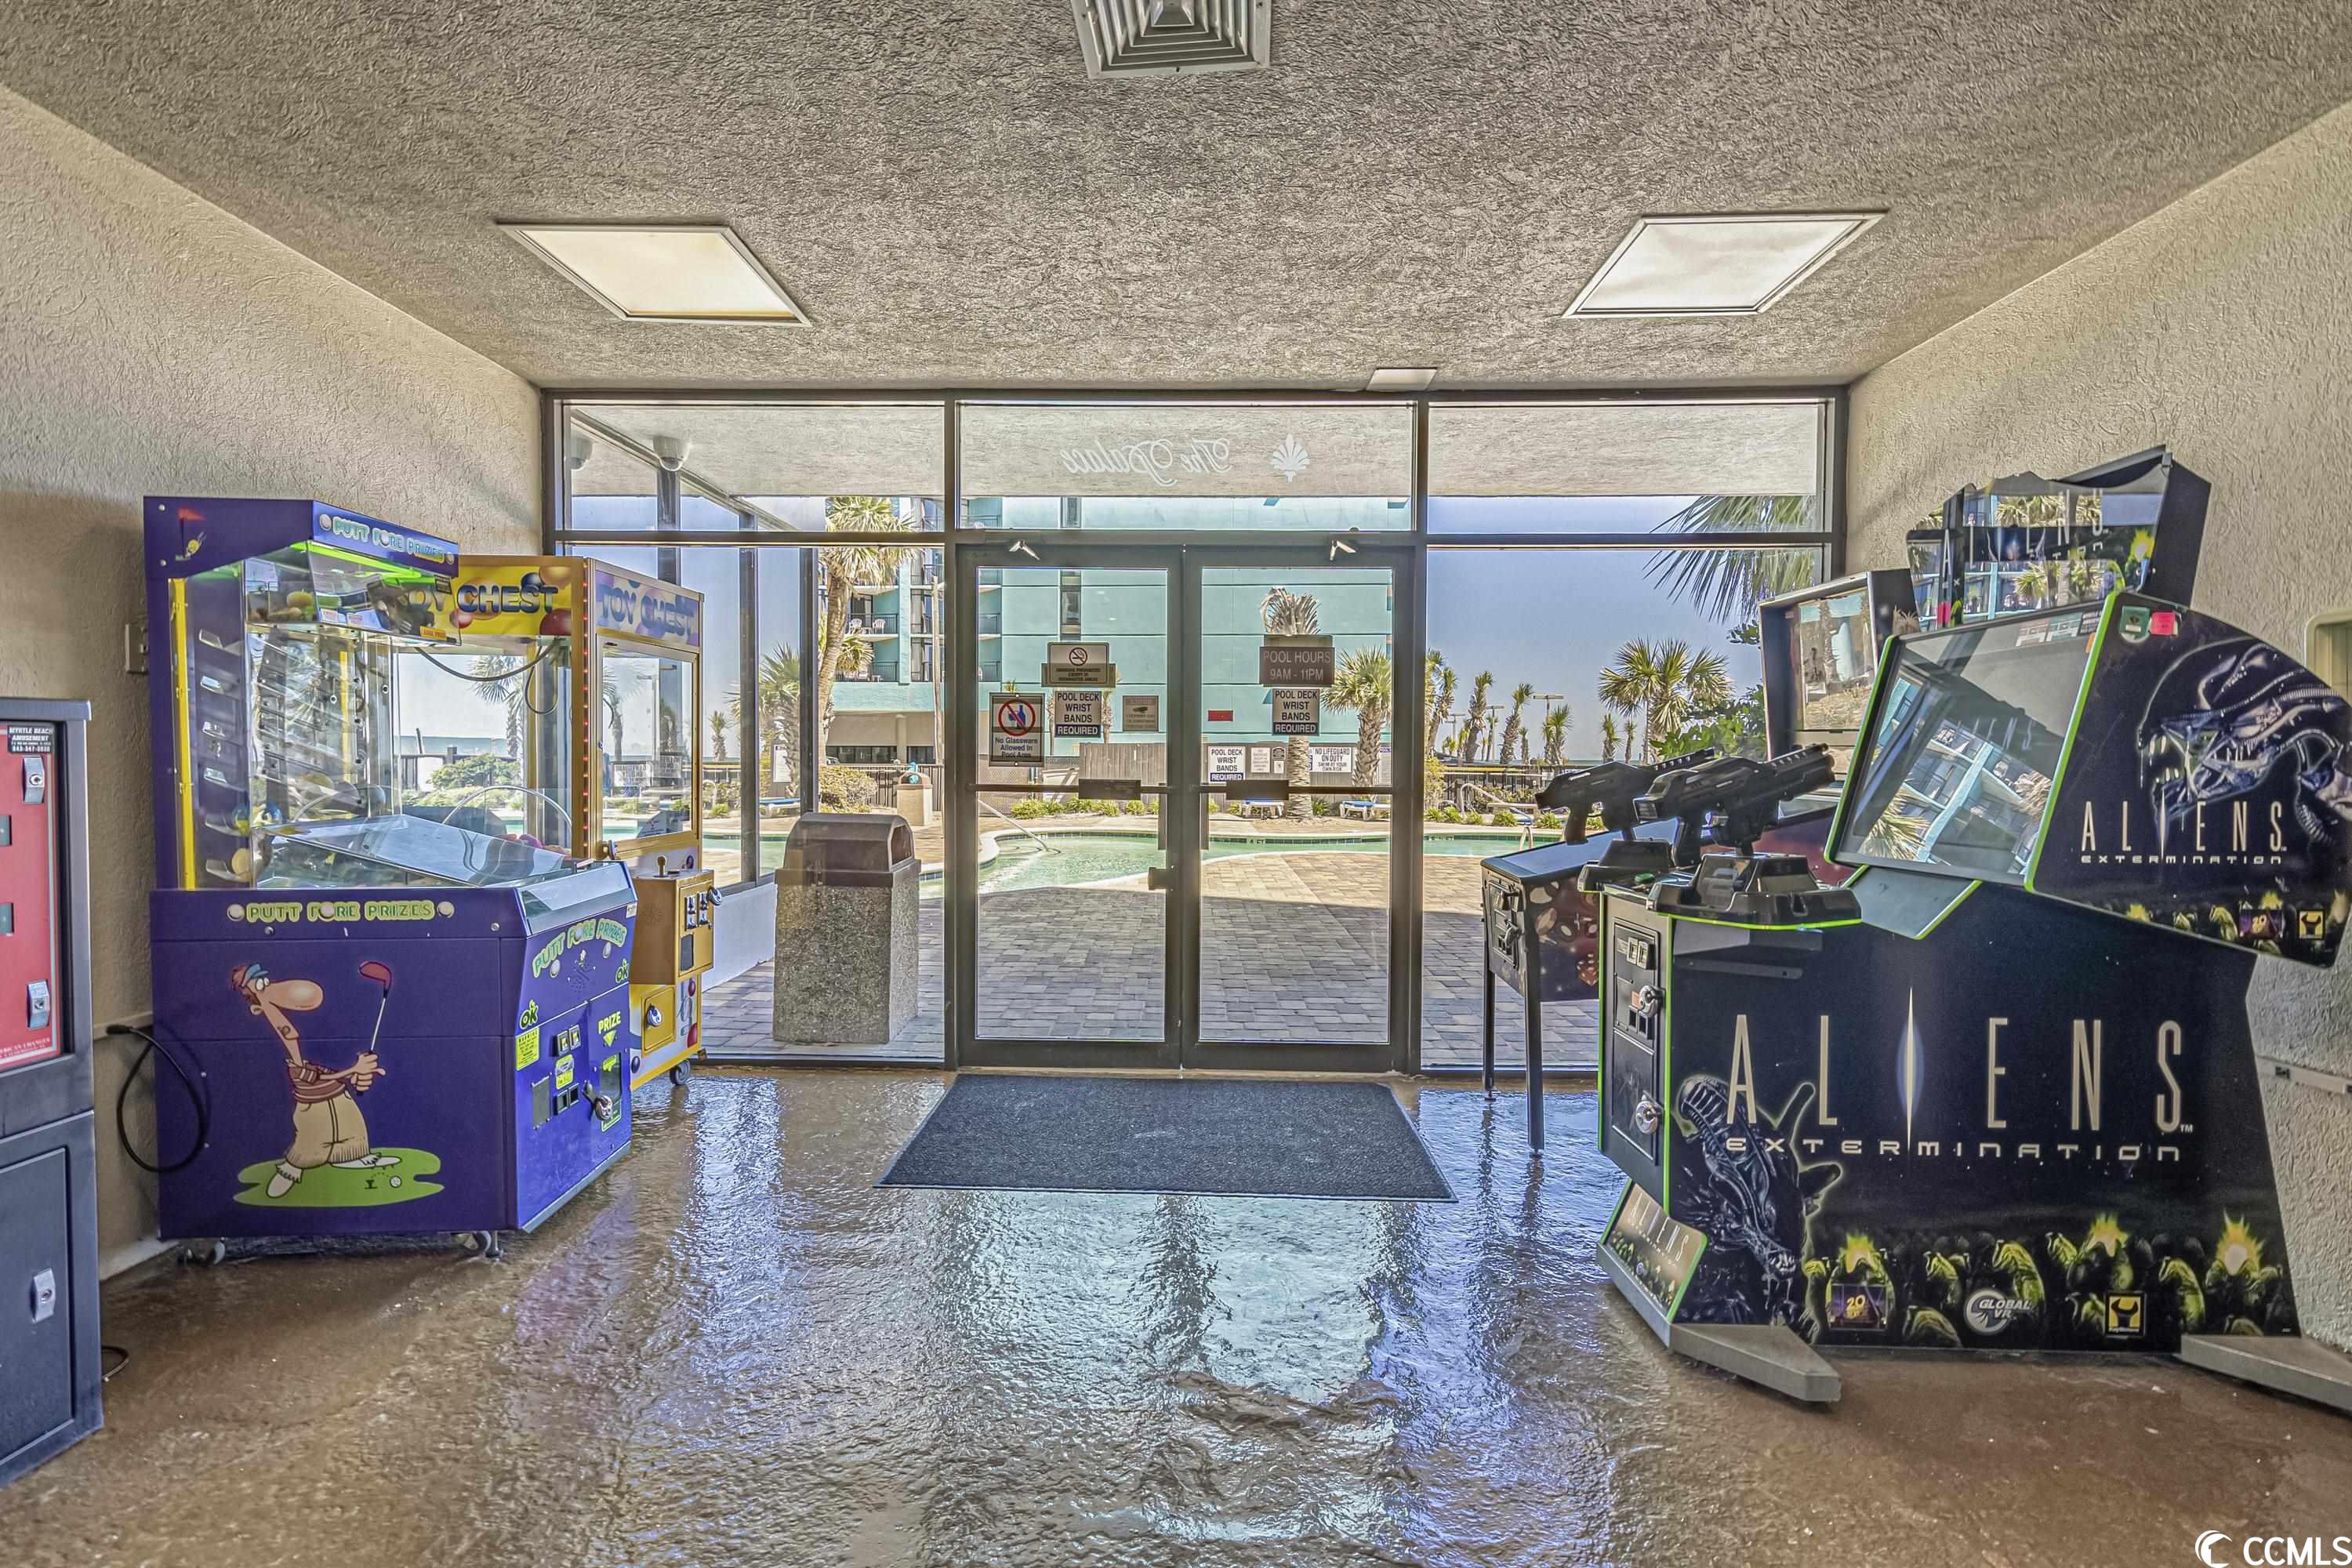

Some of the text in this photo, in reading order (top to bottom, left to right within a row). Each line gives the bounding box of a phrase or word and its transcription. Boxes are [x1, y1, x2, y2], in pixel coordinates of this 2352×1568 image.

[332, 517, 370, 543] PUTT
[457, 584, 558, 614] CHEST
[600, 584, 695, 637] TOY CHEST
[1263, 651, 1331, 664] POOL HOURS
[1270, 669, 1291, 681] 9AM
[1301, 669, 1324, 681] 11PM
[1057, 692, 1100, 702] POOL DECK
[1275, 691, 1317, 699] POOL DECK
[1065, 703, 1091, 712] WRIST
[1283, 702, 1309, 710] WRIST
[1064, 714, 1092, 723] BANDS
[1281, 712, 1311, 720] BANDS
[1058, 726, 1098, 735] REQUIRED
[1275, 724, 1316, 733] REQUIRED
[2082, 798, 2282, 853] ALIENS
[2080, 855, 2282, 864] EXTERMINATION
[246, 902, 302, 921] PUTT
[364, 900, 434, 920] PRIZES
[532, 931, 565, 978] PUTT
[596, 917, 628, 948] PRIZES
[597, 1011, 622, 1035] PRIZE
[1726, 989, 2182, 1145] ALIENS
[1726, 1138, 2180, 1162] EXTERMINATION
[1630, 1192, 1689, 1261] ALIENS
[1978, 1298, 2032, 1312] GLOBAL
[1994, 1309, 2013, 1320] VR
